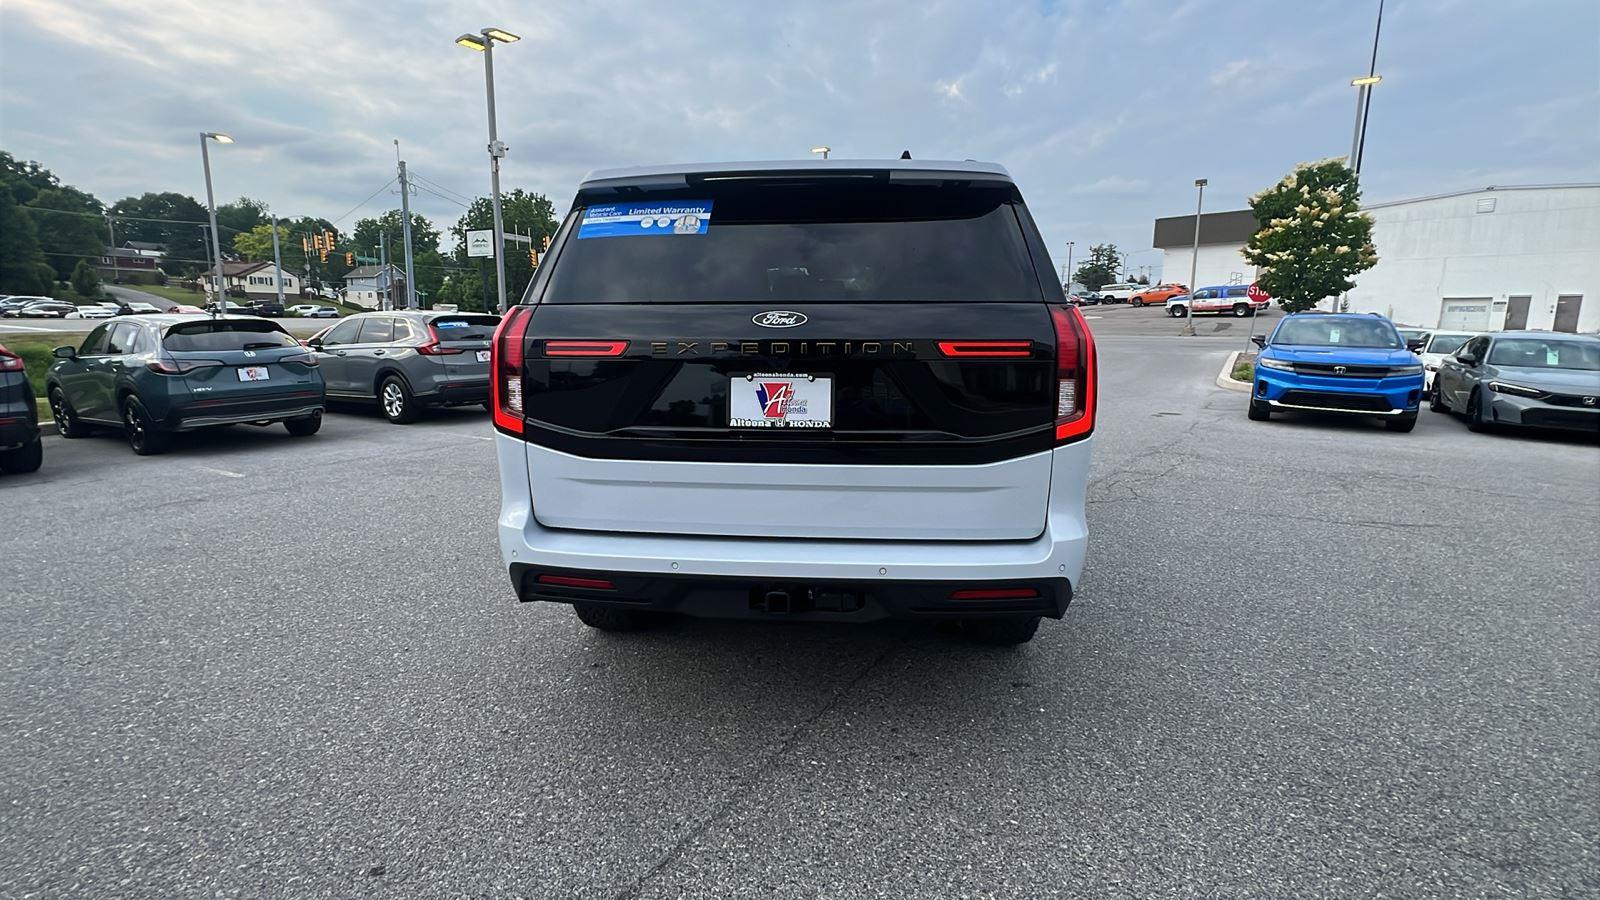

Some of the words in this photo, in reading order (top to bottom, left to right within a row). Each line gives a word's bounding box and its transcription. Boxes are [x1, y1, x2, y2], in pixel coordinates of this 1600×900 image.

[628, 207, 661, 215] Limited
[762, 311, 797, 324] Ford
[650, 342, 913, 354] EXPEDITION
[780, 405, 806, 413] Honda
[729, 419, 772, 427] Altoona
[788, 420, 832, 428] HONDA
